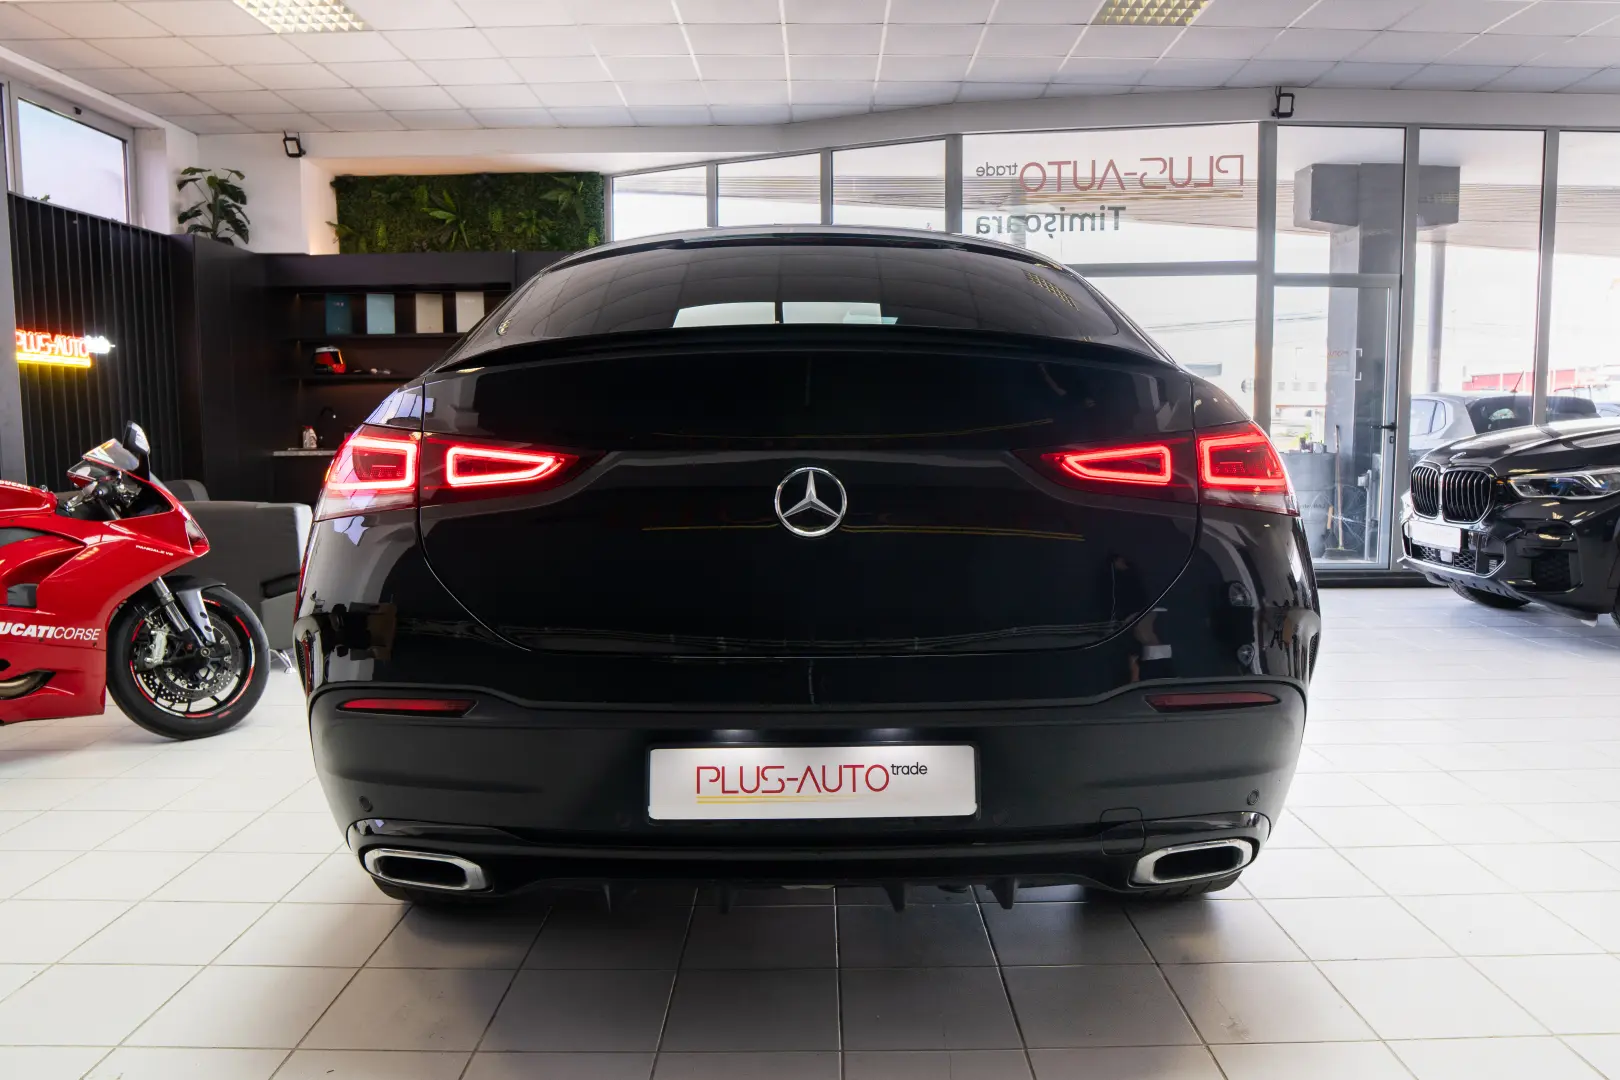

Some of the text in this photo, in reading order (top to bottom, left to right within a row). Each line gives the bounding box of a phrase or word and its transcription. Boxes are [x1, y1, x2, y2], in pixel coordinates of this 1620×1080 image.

[0, 621, 101, 640] UCATICORSE
[696, 762, 928, 794] PLUS-AUTO trade
